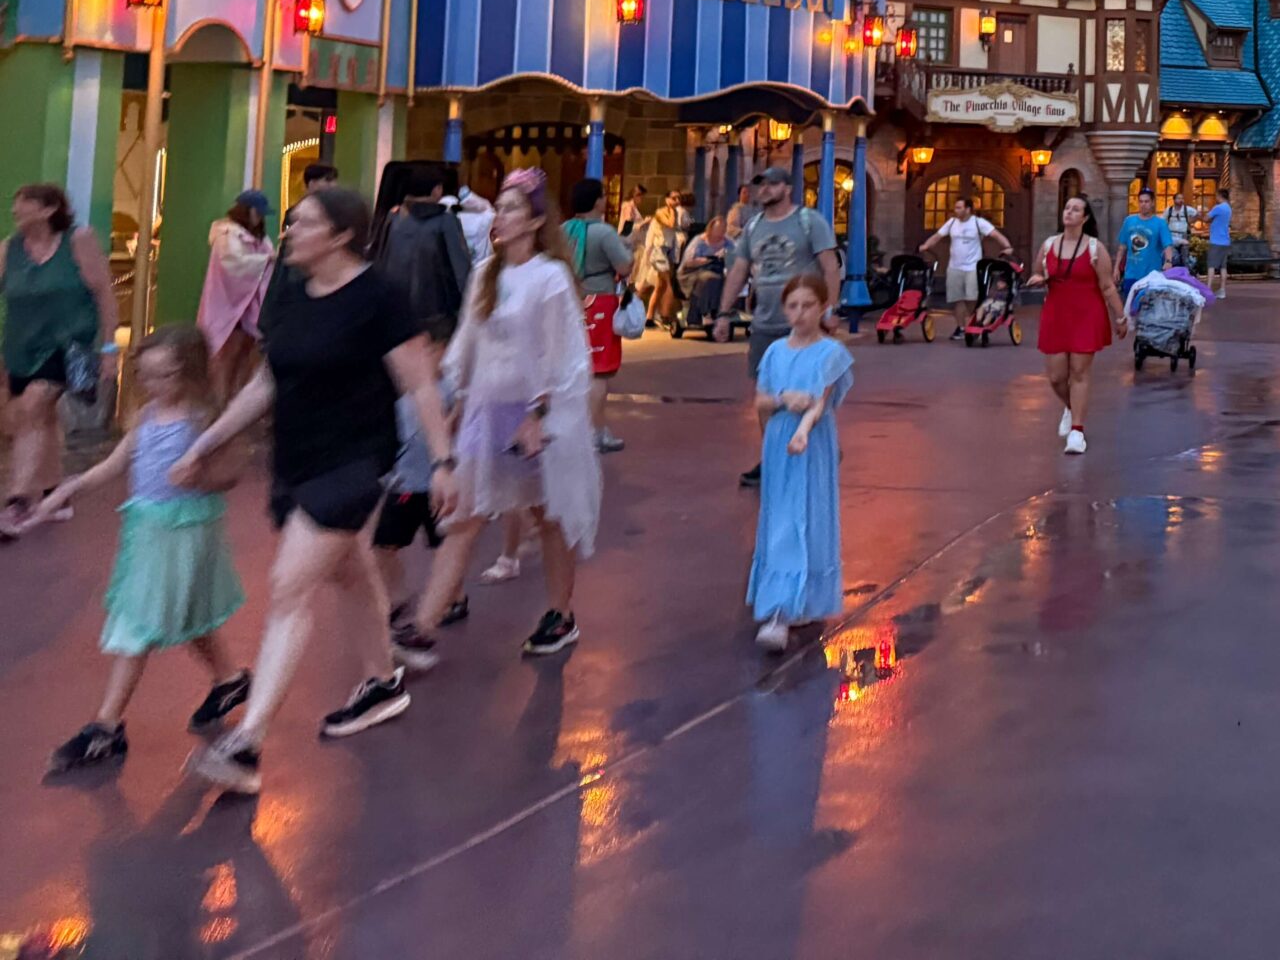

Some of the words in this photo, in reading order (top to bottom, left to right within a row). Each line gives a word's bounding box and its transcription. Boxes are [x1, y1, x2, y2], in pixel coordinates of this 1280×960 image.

[944, 100, 961, 113] The
[965, 99, 1008, 113] Pinocchio
[1012, 99, 1042, 117] Village
[1045, 104, 1066, 117] Haus
